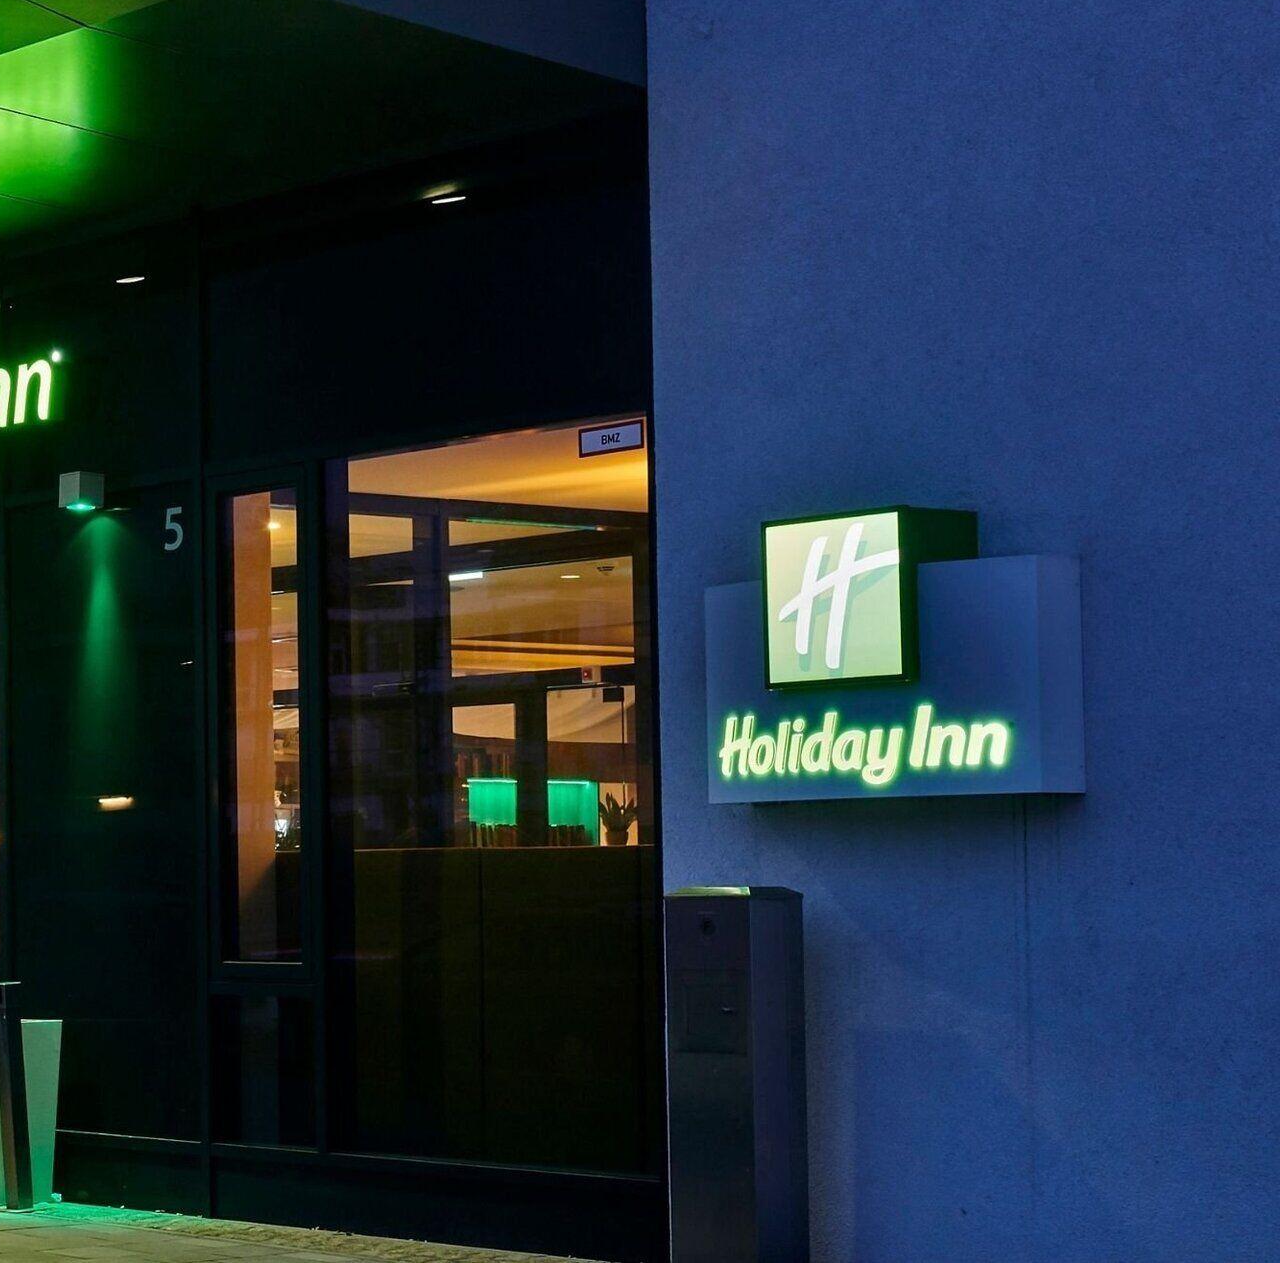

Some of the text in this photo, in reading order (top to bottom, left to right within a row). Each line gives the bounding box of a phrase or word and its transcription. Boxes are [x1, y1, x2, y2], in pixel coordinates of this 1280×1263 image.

[601, 433, 621, 445] BMZ
[163, 506, 183, 551] 5
[719, 704, 1008, 786] Holiday Inn
